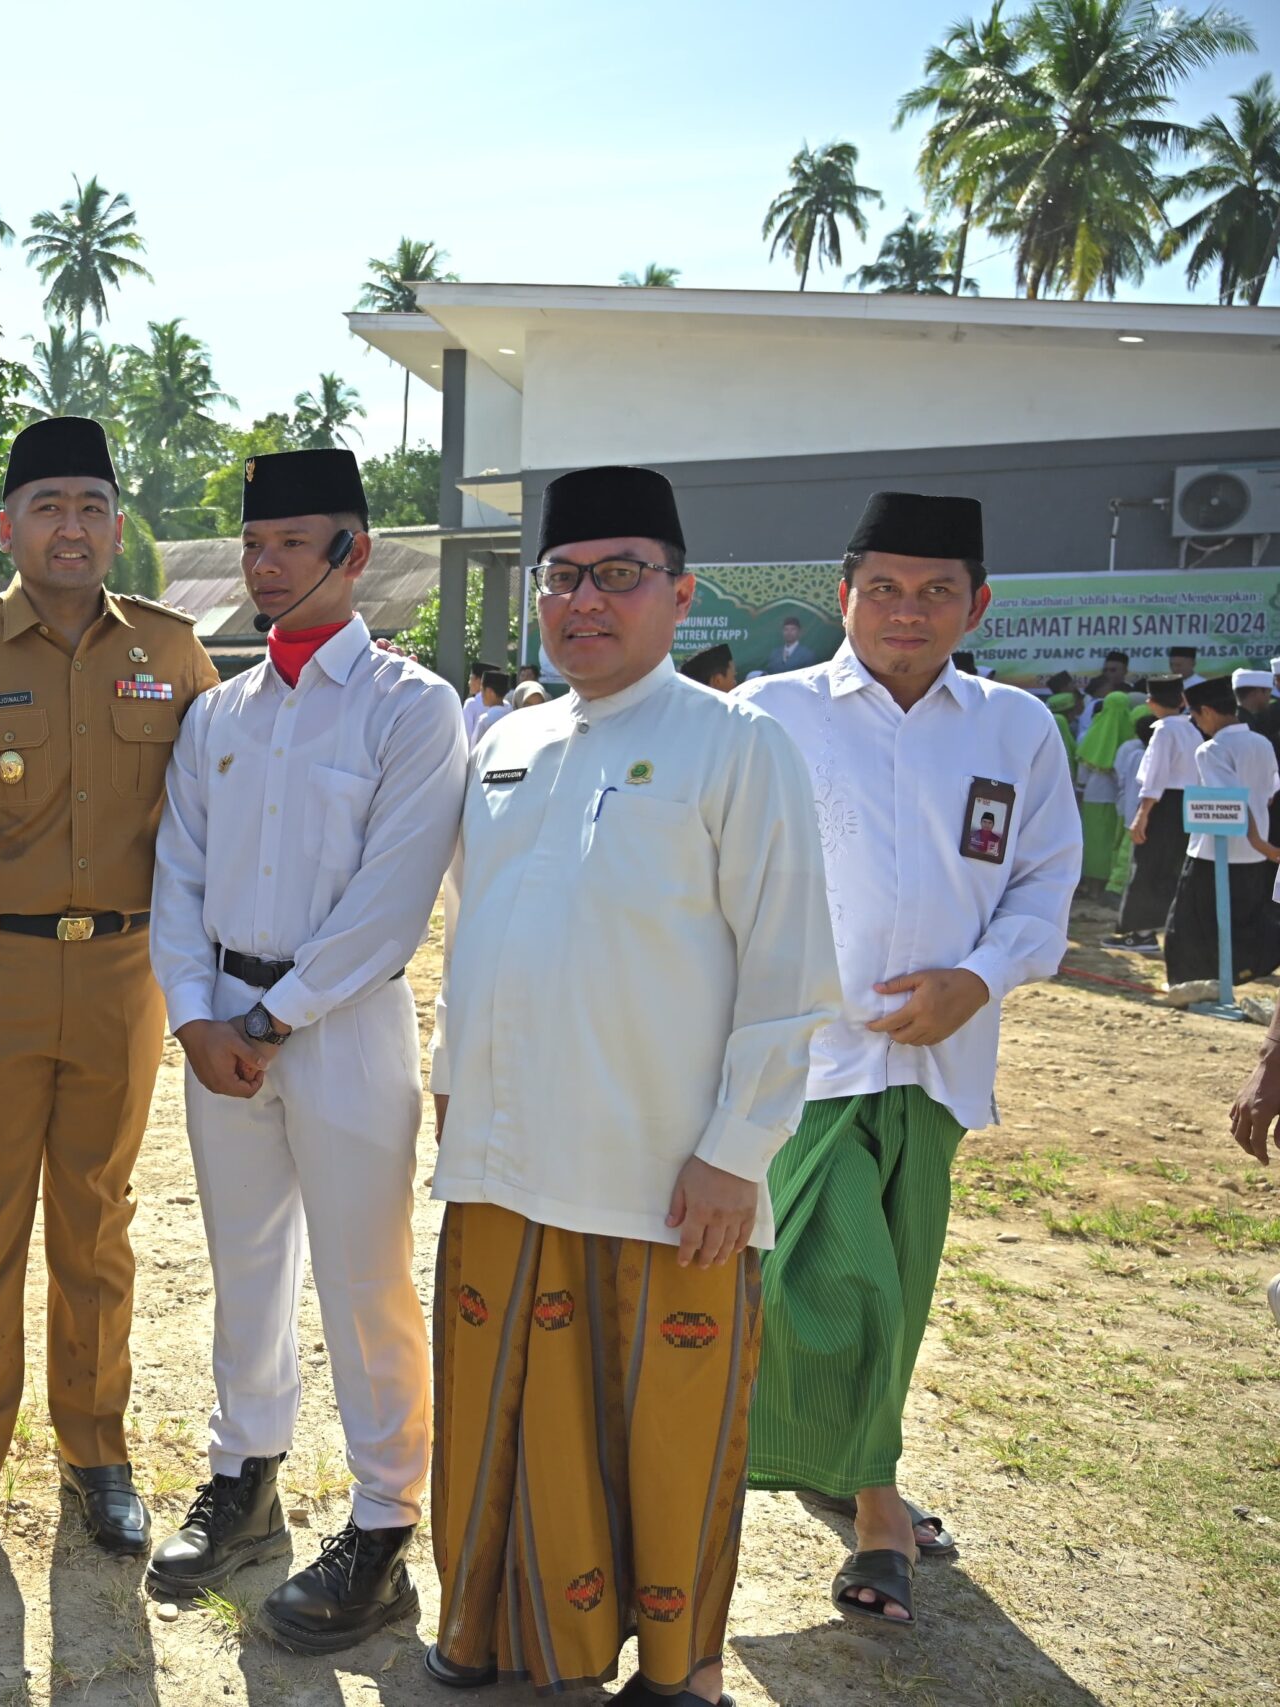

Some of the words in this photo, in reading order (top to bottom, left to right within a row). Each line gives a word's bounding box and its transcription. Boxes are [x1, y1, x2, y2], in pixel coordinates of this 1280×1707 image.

[983, 616, 1072, 638] SELAMAT
[1077, 615, 1127, 637] HARI
[1132, 613, 1208, 636] SANTRI
[1213, 611, 1266, 634] 2024
[1216, 803, 1242, 812] PONPES
[1194, 812, 1211, 820] KOTA
